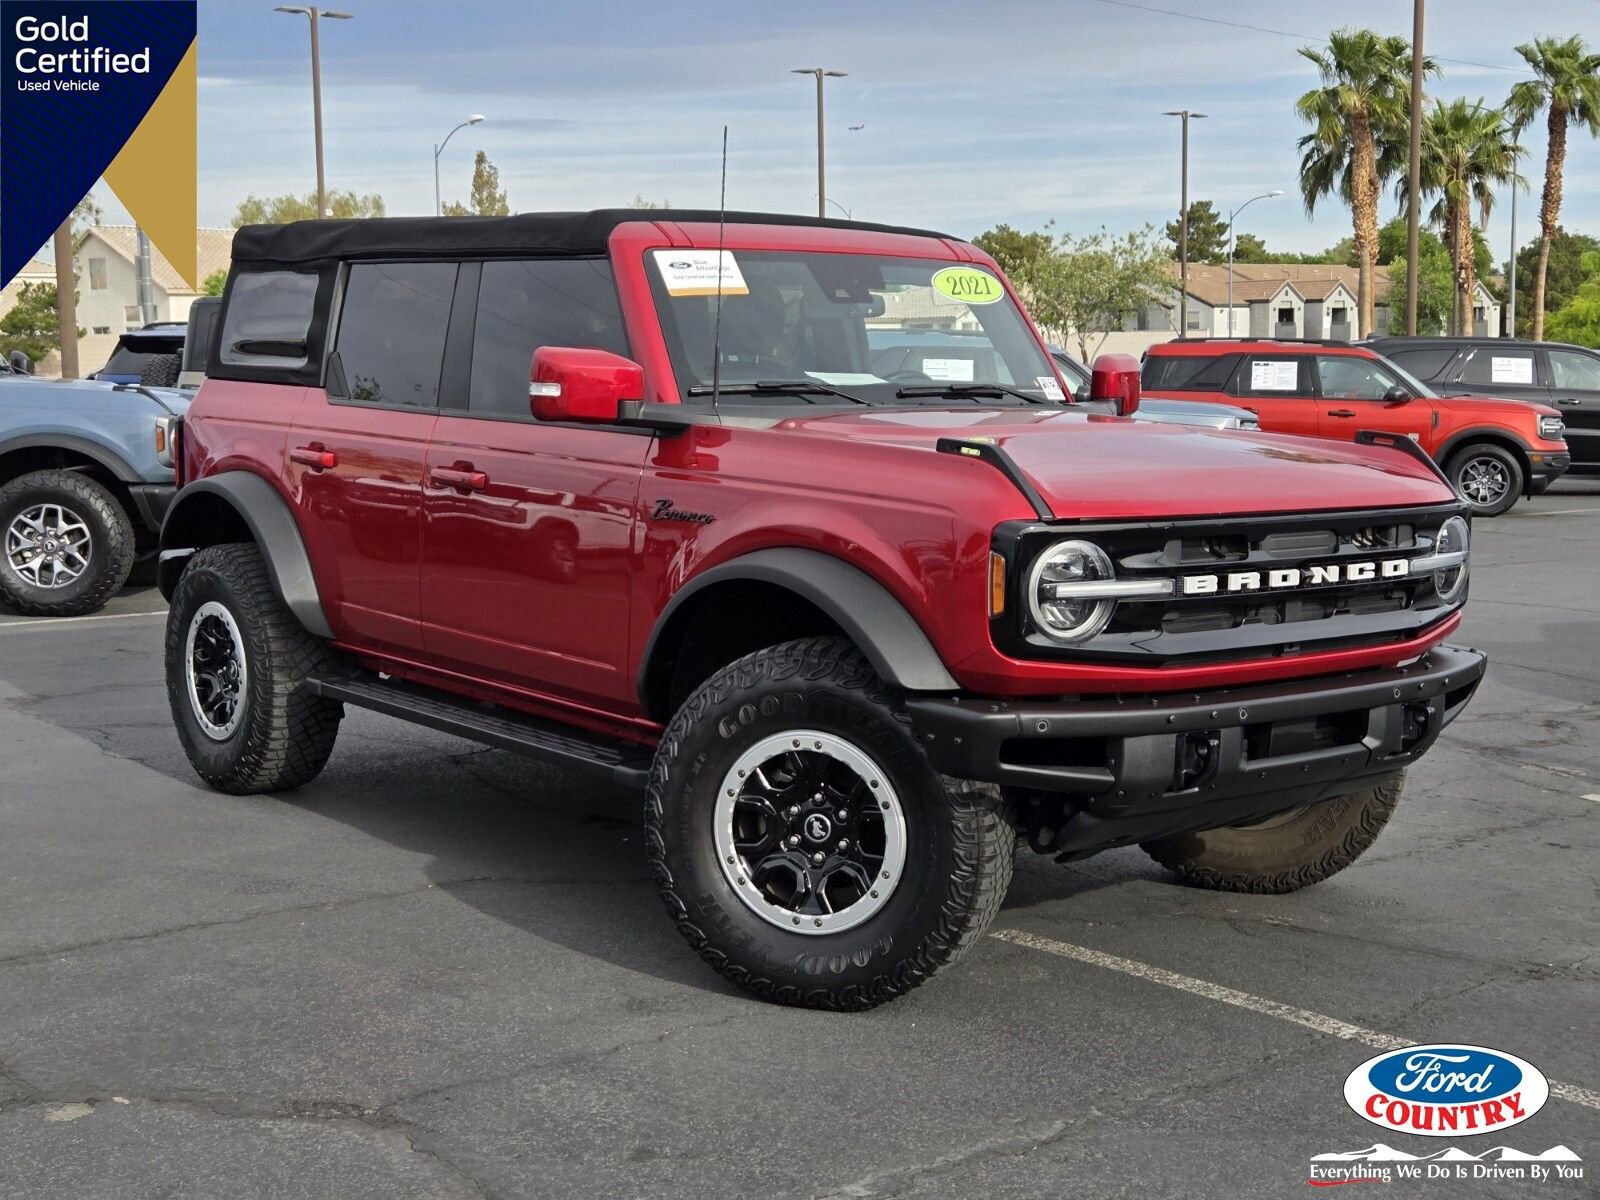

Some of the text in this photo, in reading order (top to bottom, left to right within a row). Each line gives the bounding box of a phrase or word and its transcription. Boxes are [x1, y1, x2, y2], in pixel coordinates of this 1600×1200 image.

[946, 276, 992, 295] 2021
[649, 498, 717, 525] Bronco
[1183, 558, 1409, 595] BRONCO
